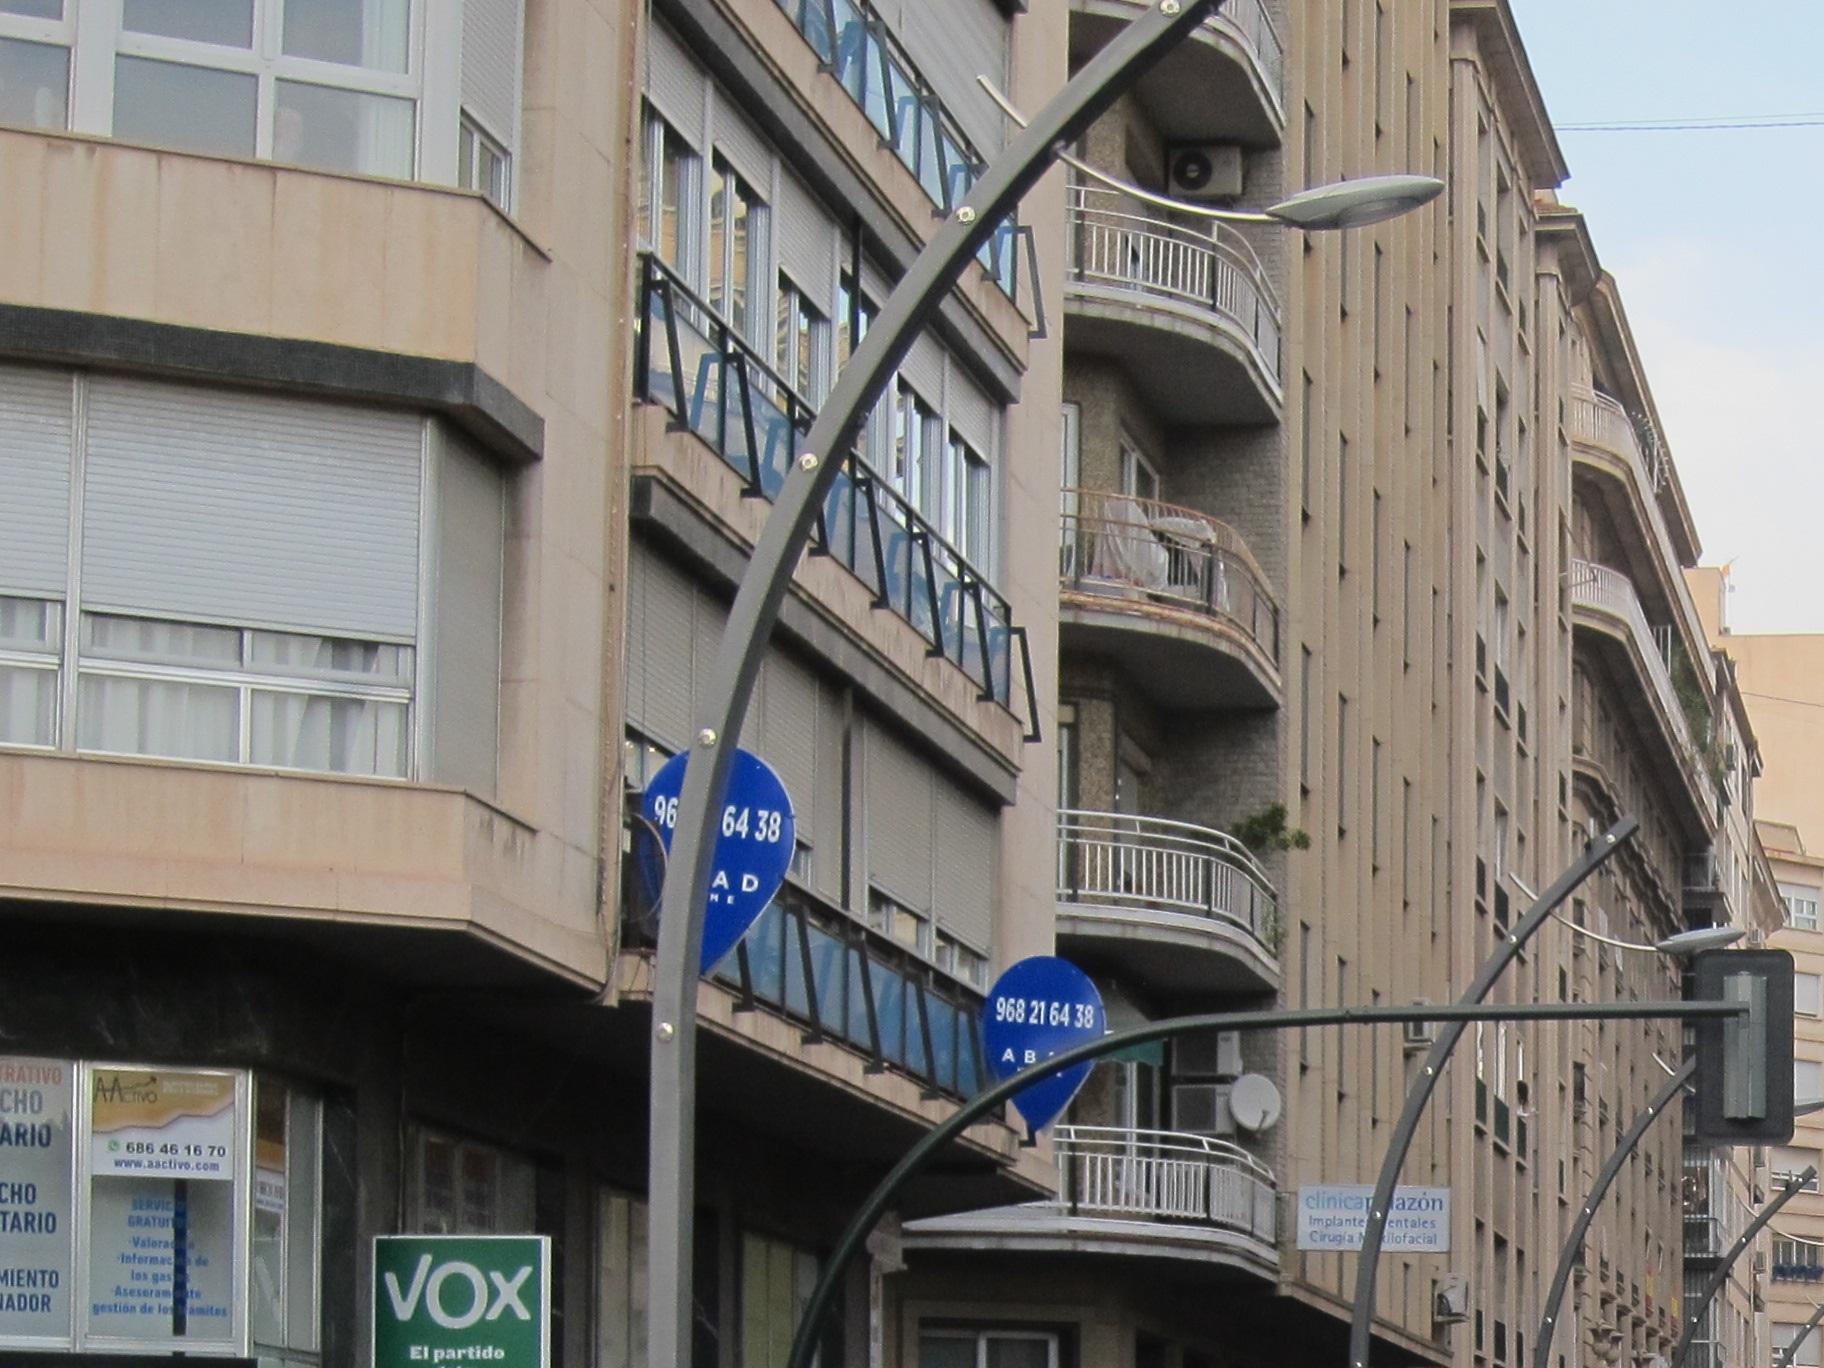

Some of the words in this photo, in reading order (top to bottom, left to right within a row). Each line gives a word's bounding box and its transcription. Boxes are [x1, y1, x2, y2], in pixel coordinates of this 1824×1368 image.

[654, 794, 679, 829] 96
[722, 804, 750, 839] 64
[755, 809, 782, 843] 38
[996, 996, 1025, 1023] 968
[1029, 1000, 1046, 1025] 21
[1049, 1002, 1070, 1027] 64
[1074, 1003, 1094, 1028] 38
[4, 1063, 63, 1085] RATIVO
[126, 1141, 154, 1155] 686
[160, 1143, 179, 1155] 46
[185, 1144, 202, 1157] 16
[208, 1145, 226, 1158] 70
[114, 1157, 220, 1172] www.aactivo.com
[1309, 1215, 1365, 1229] Implante
[1388, 1216, 1436, 1229] entales
[384, 1253, 534, 1329] VOX
[409, 1344, 429, 1361] El
[433, 1345, 505, 1363] partido
